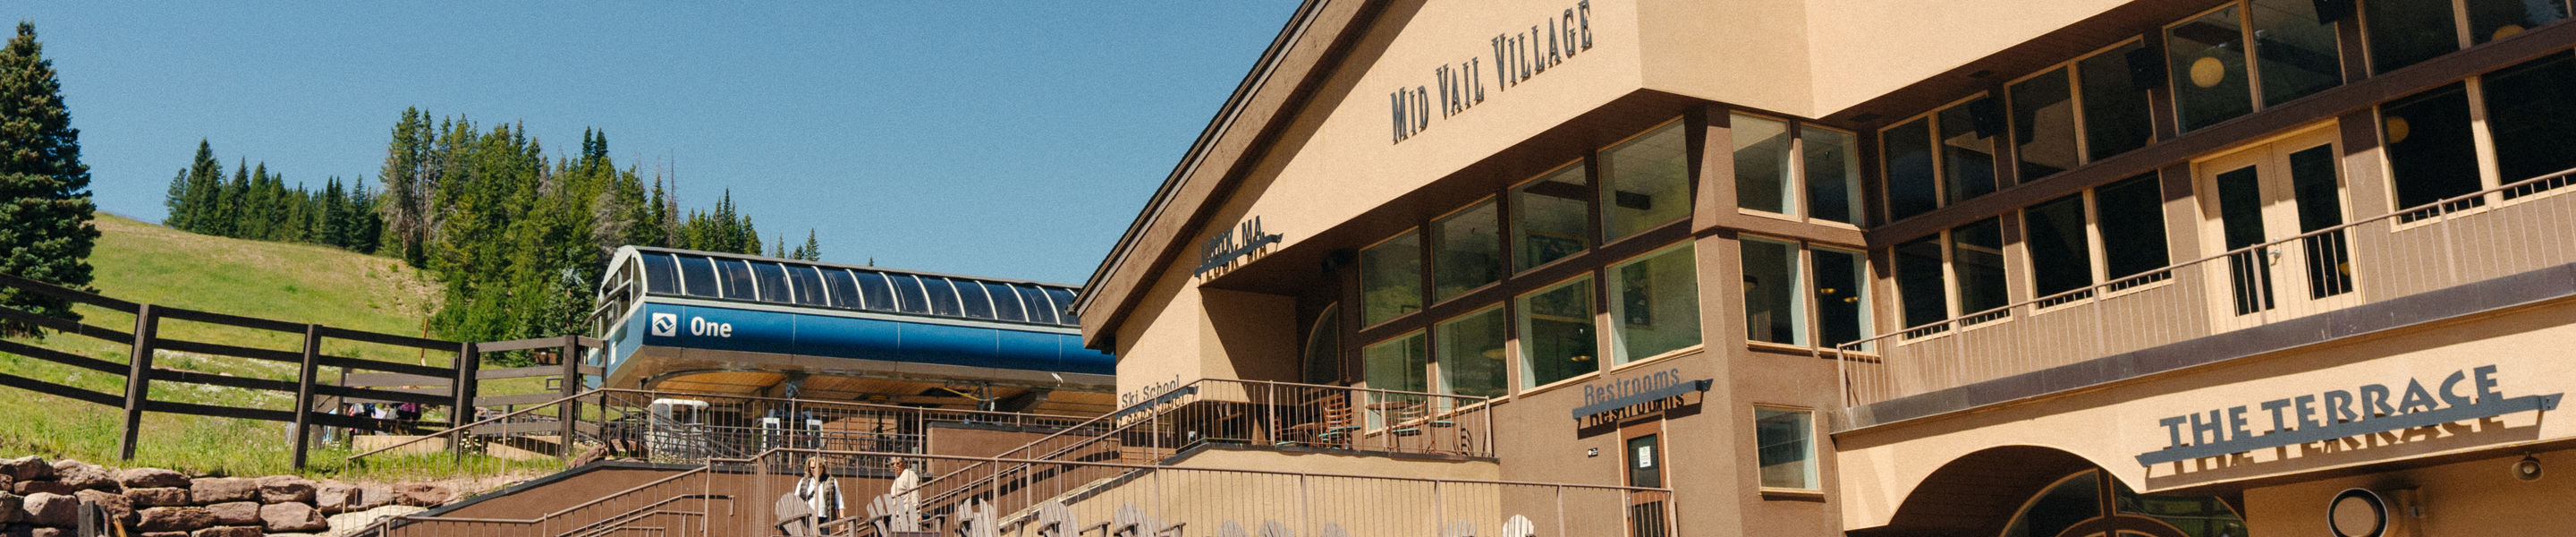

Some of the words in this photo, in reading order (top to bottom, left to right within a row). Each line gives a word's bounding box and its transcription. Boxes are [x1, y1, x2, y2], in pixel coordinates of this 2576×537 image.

[1390, 85, 1429, 143] MID
[1436, 56, 1485, 119] VAIL
[1491, 0, 1592, 91] VILLAGE
[691, 316, 733, 337] One
[1122, 389, 1139, 409] Ski
[1143, 374, 1180, 401] School
[1584, 368, 1681, 406] Restrooms
[2159, 405, 2252, 448] THE
[2261, 364, 2504, 434] TERRACE
